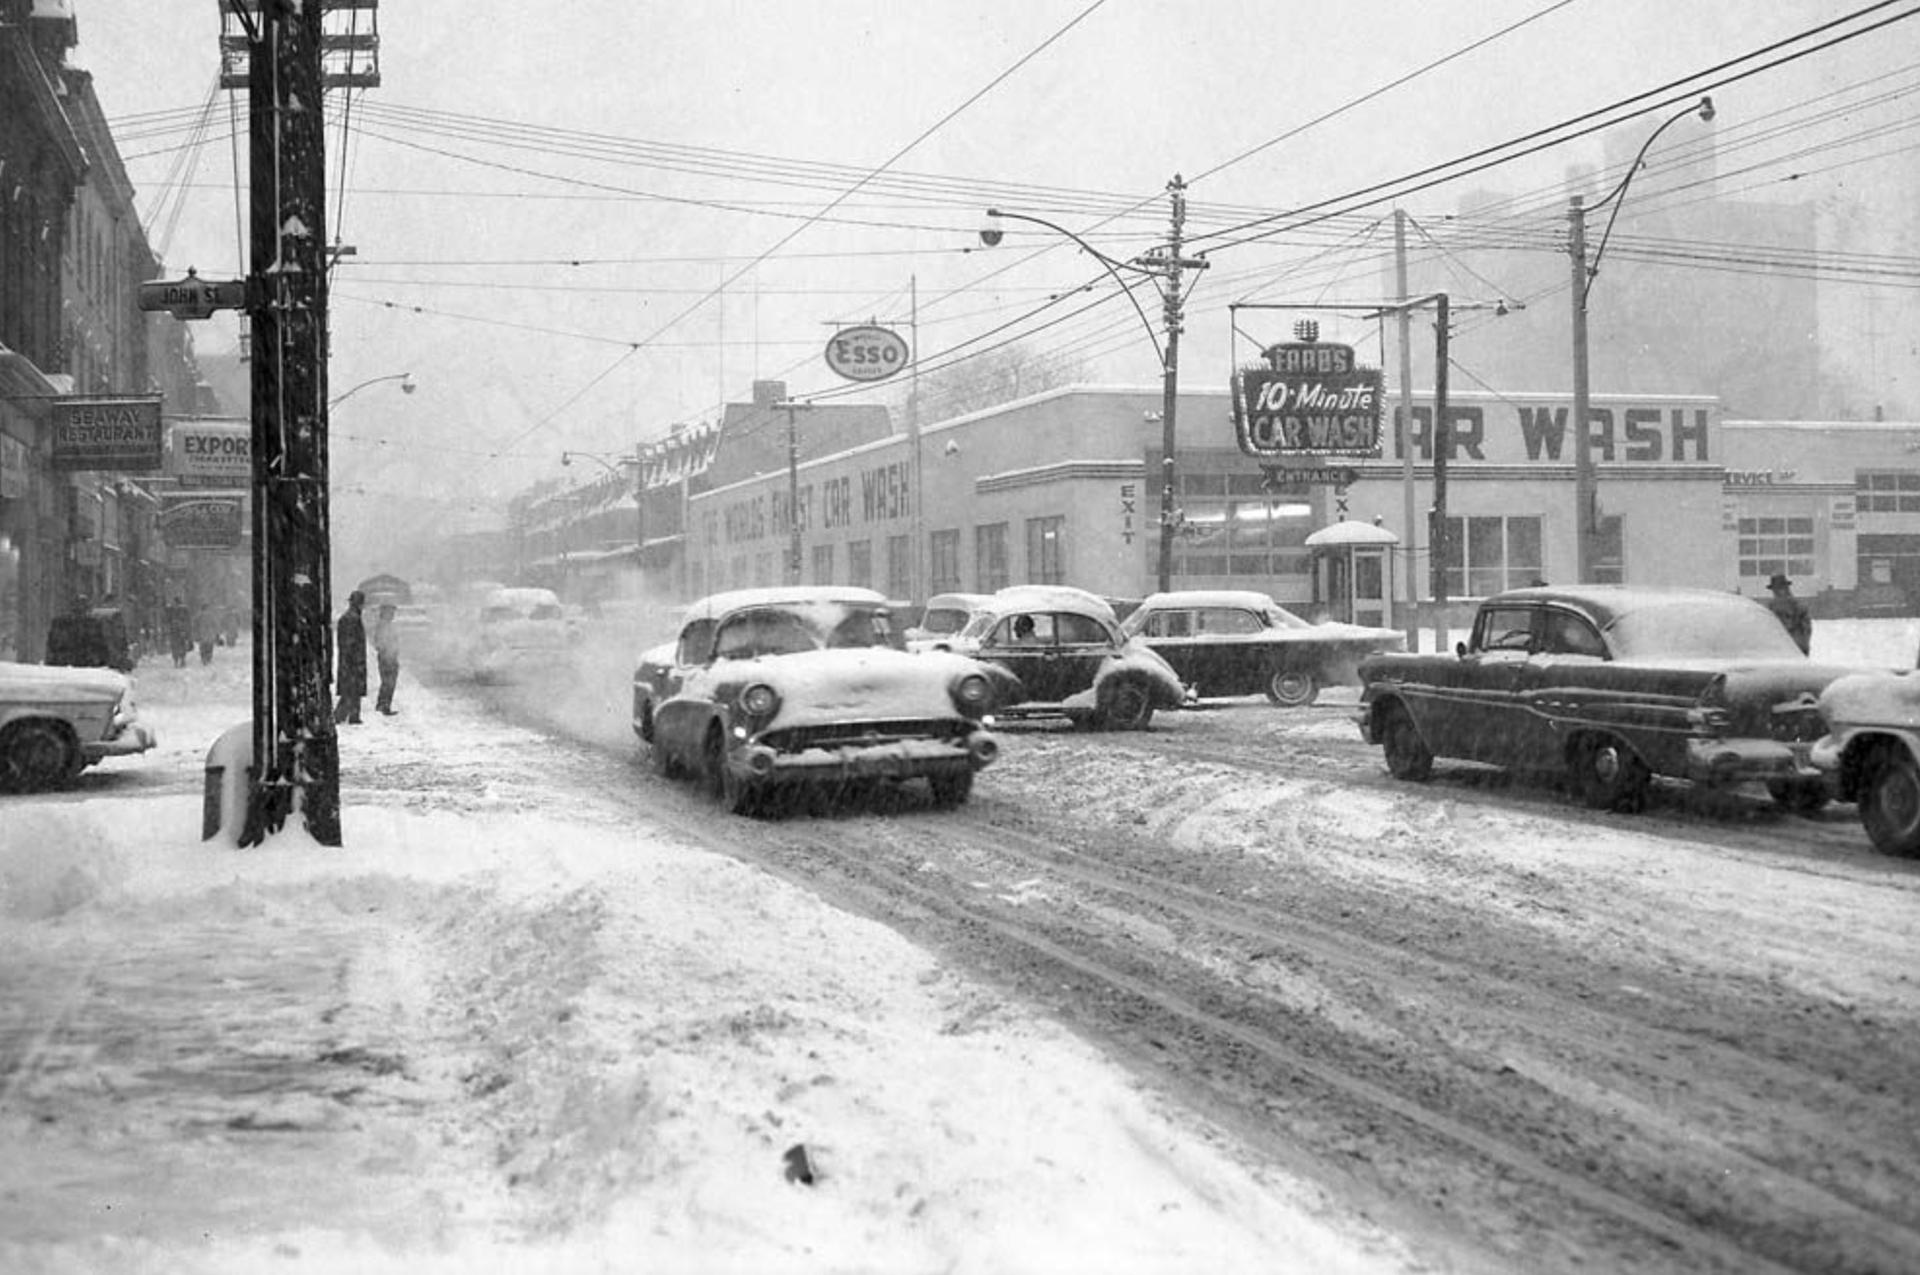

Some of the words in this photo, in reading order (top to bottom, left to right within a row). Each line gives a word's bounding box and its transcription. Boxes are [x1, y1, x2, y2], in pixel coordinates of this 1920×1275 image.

[160, 287, 198, 305] JOHN
[836, 339, 898, 364] ESSO
[1254, 415, 1301, 448] CAR
[1307, 415, 1374, 448] WASH
[1394, 406, 1485, 460] AR
[1518, 407, 1709, 461] WASH
[1724, 471, 1773, 485] ERVICE
[824, 477, 850, 529] CAR
[861, 461, 910, 522] WASH
[1121, 485, 1135, 545] EXIT
